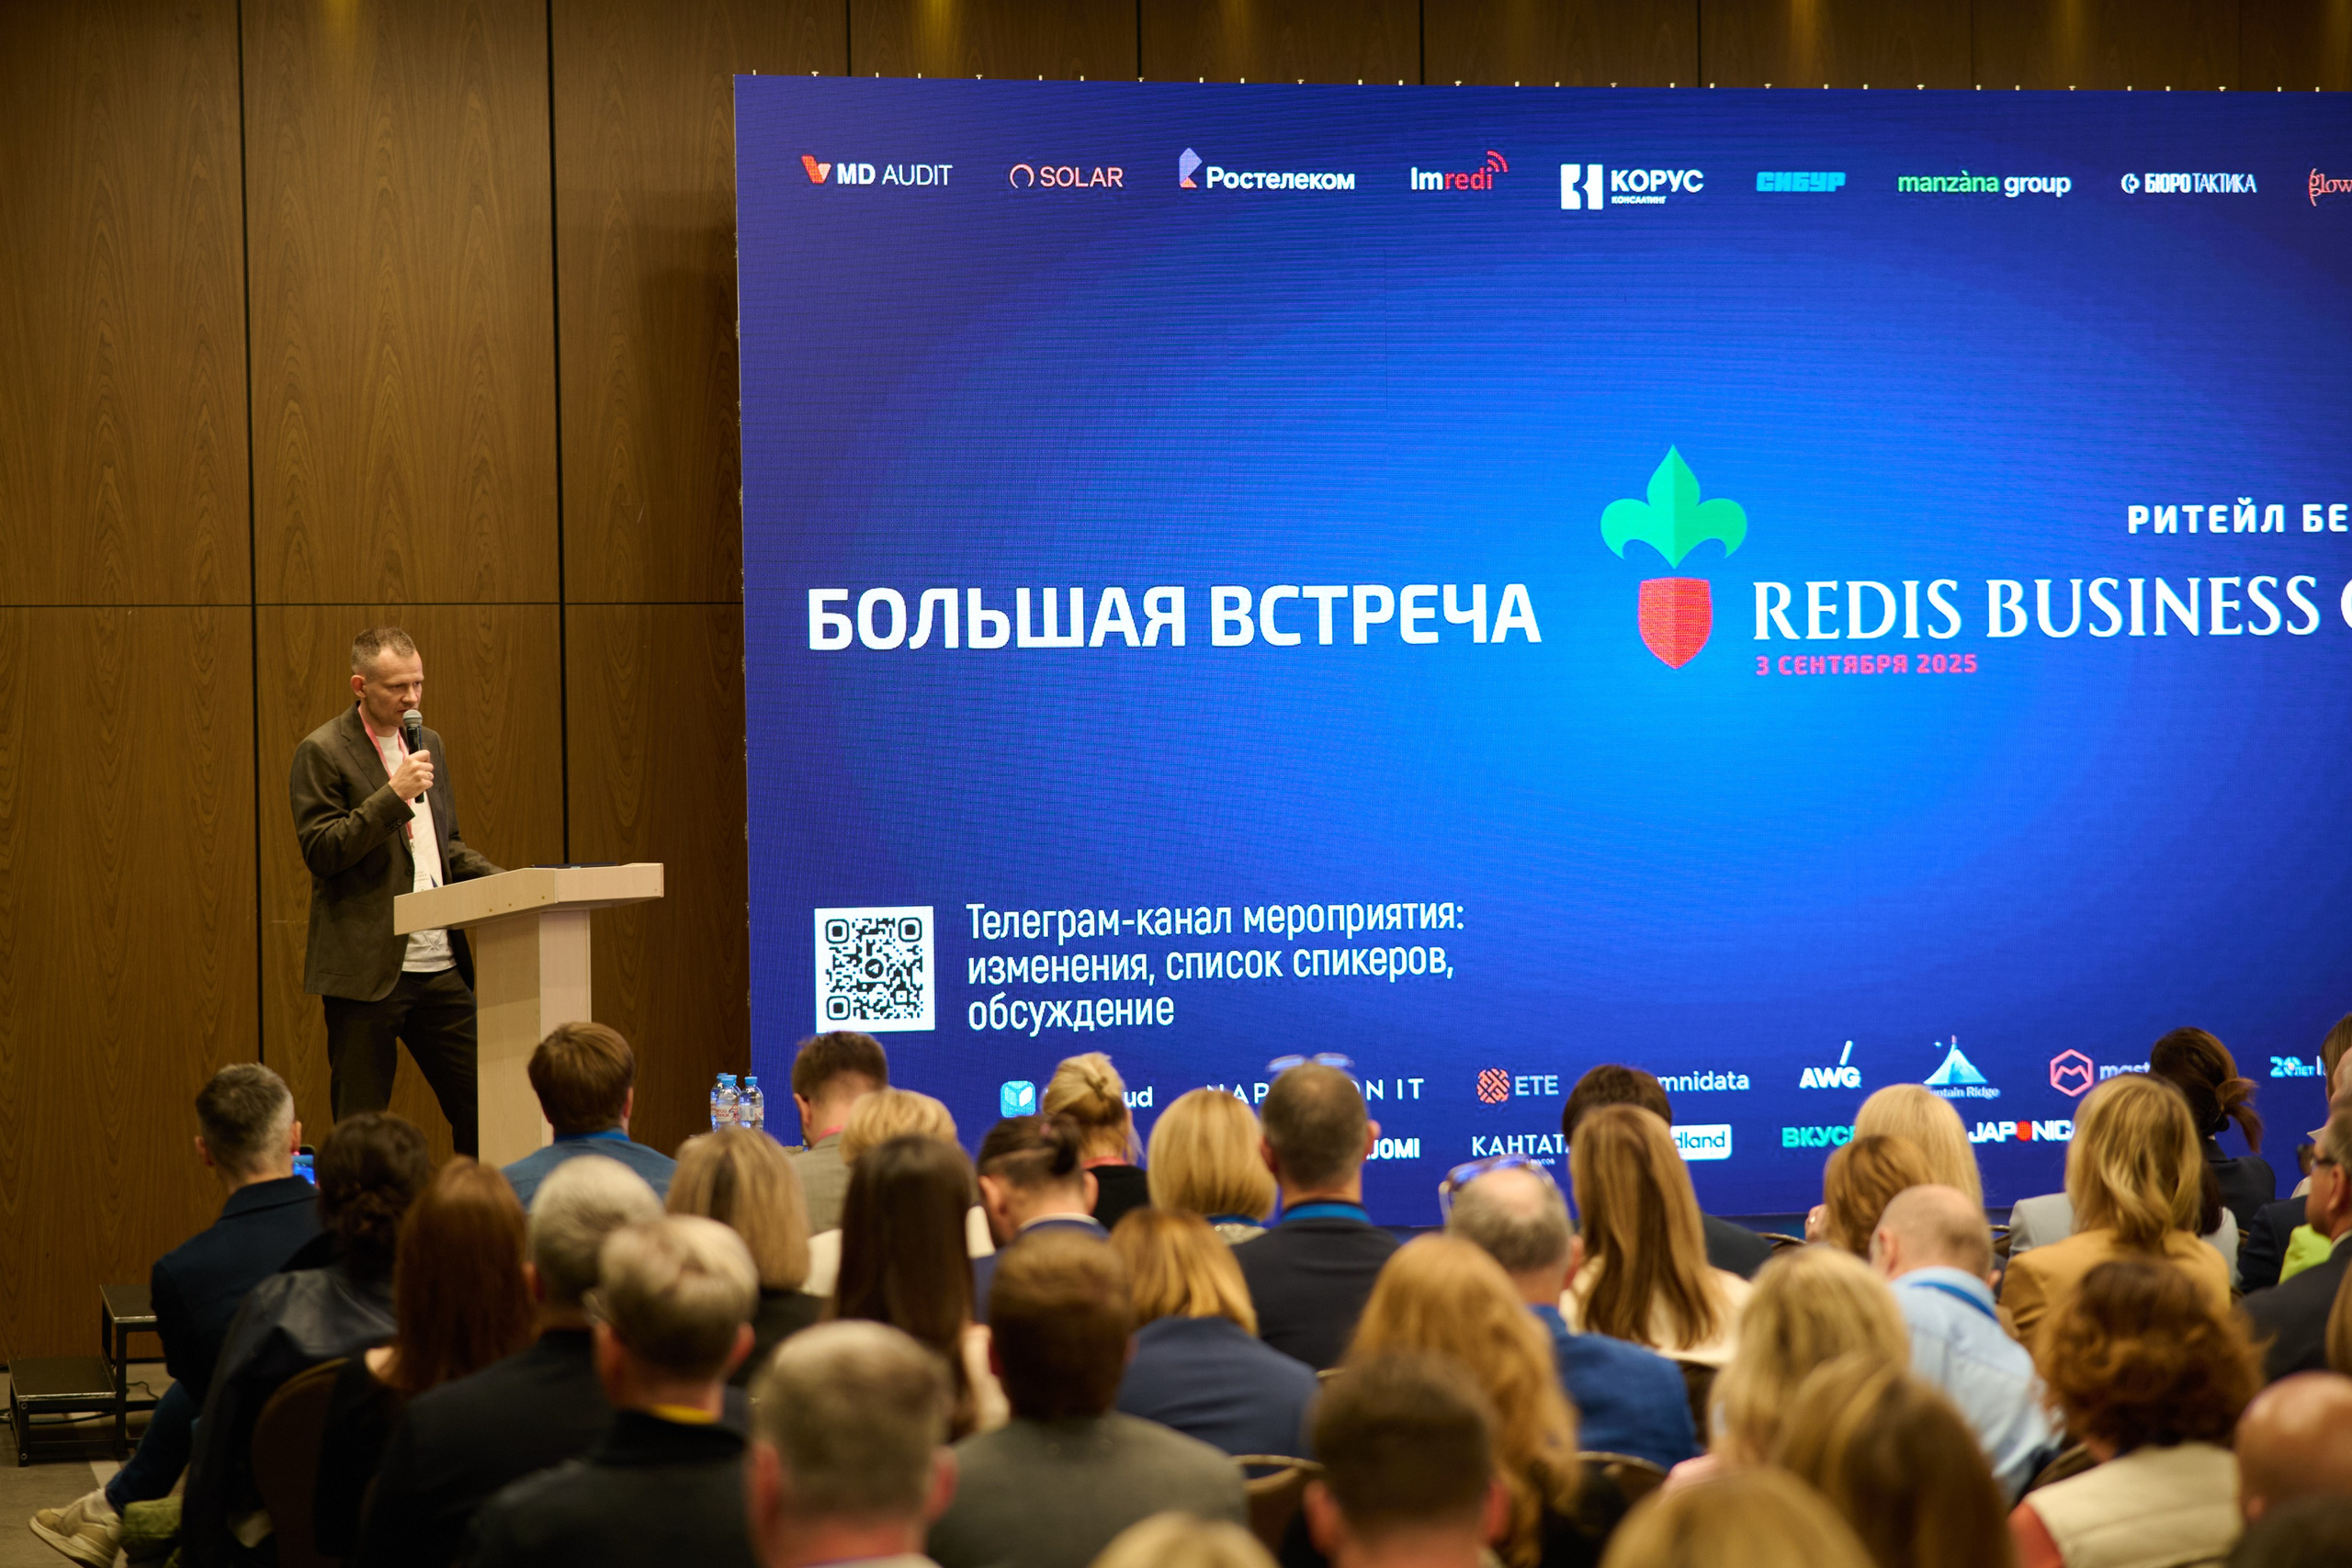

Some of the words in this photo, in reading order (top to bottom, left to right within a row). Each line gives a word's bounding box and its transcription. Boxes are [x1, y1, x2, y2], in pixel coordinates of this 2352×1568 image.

[836, 164, 876, 185] MD
[881, 164, 954, 186] AUDIT
[1039, 165, 1124, 187] SOLAR
[1205, 165, 1356, 191] Ростелеком
[1611, 168, 1704, 193] КОРУС
[1756, 172, 1847, 192] СИБУР
[2003, 175, 2073, 198] group
[2128, 497, 2285, 535] РИТЕЙЛ
[808, 585, 1186, 651] БОЛЬШАЯ
[1210, 583, 1543, 647] ВСТРЕЧА
[1753, 579, 1962, 640] REDIS
[1985, 574, 2320, 638] BUSINESS
[1755, 655, 1770, 676] 3
[1778, 655, 1908, 675] СЕНТЯБРЯ
[1917, 653, 1977, 674] 2025
[966, 902, 1232, 945] Телеграм-канал
[1243, 900, 1465, 941] мероприятия:
[967, 953, 1156, 987] изменения,
[1166, 949, 1284, 981] список
[1293, 943, 1454, 984] спикеров,
[968, 990, 1174, 1038] обсуждение
[1396, 1077, 1425, 1100] IT
[1514, 1074, 1559, 1097] ETE
[1657, 1070, 1750, 1091] mnidata
[1799, 1066, 1861, 1089] AWG
[1673, 1131, 1725, 1149] dland
[1968, 1119, 2075, 1144] JAPONIC
[1472, 1133, 1569, 1156] КАНТАТ
